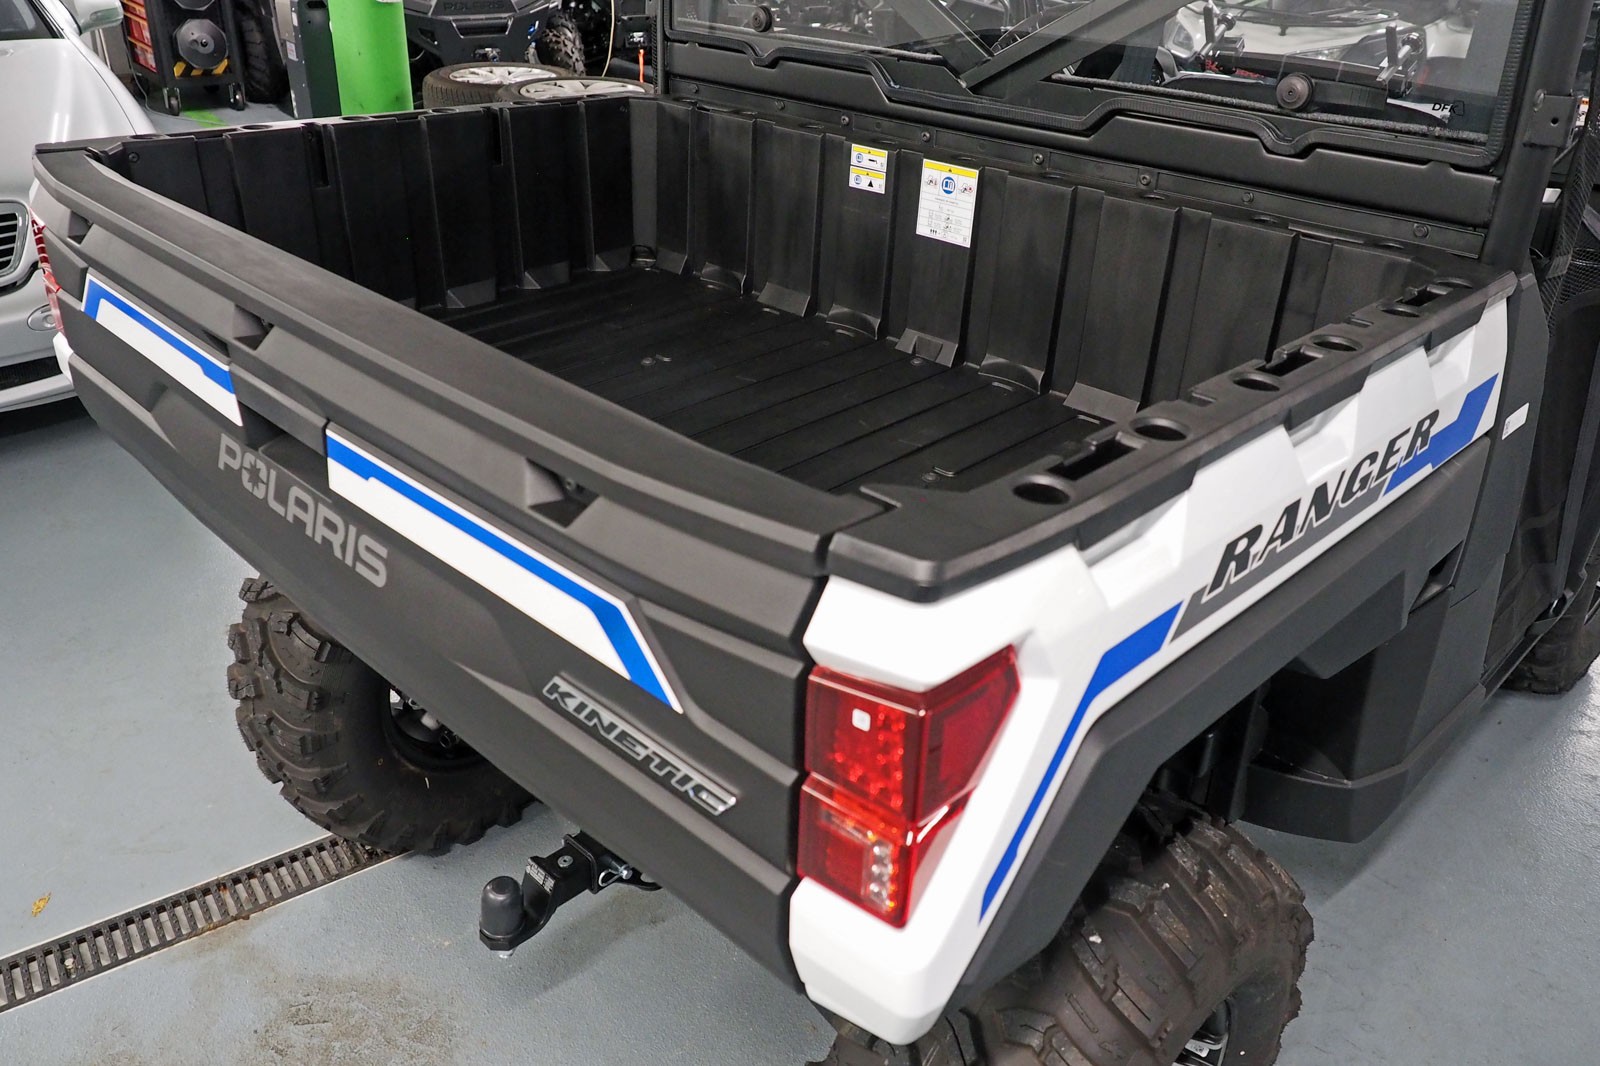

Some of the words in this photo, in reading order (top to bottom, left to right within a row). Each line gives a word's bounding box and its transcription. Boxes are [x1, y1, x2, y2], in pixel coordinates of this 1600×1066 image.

[1431, 101, 1458, 115] DFK
[218, 433, 388, 588] POLARIS
[1204, 409, 1439, 599] RANGER
[543, 676, 737, 816] KINETIC
